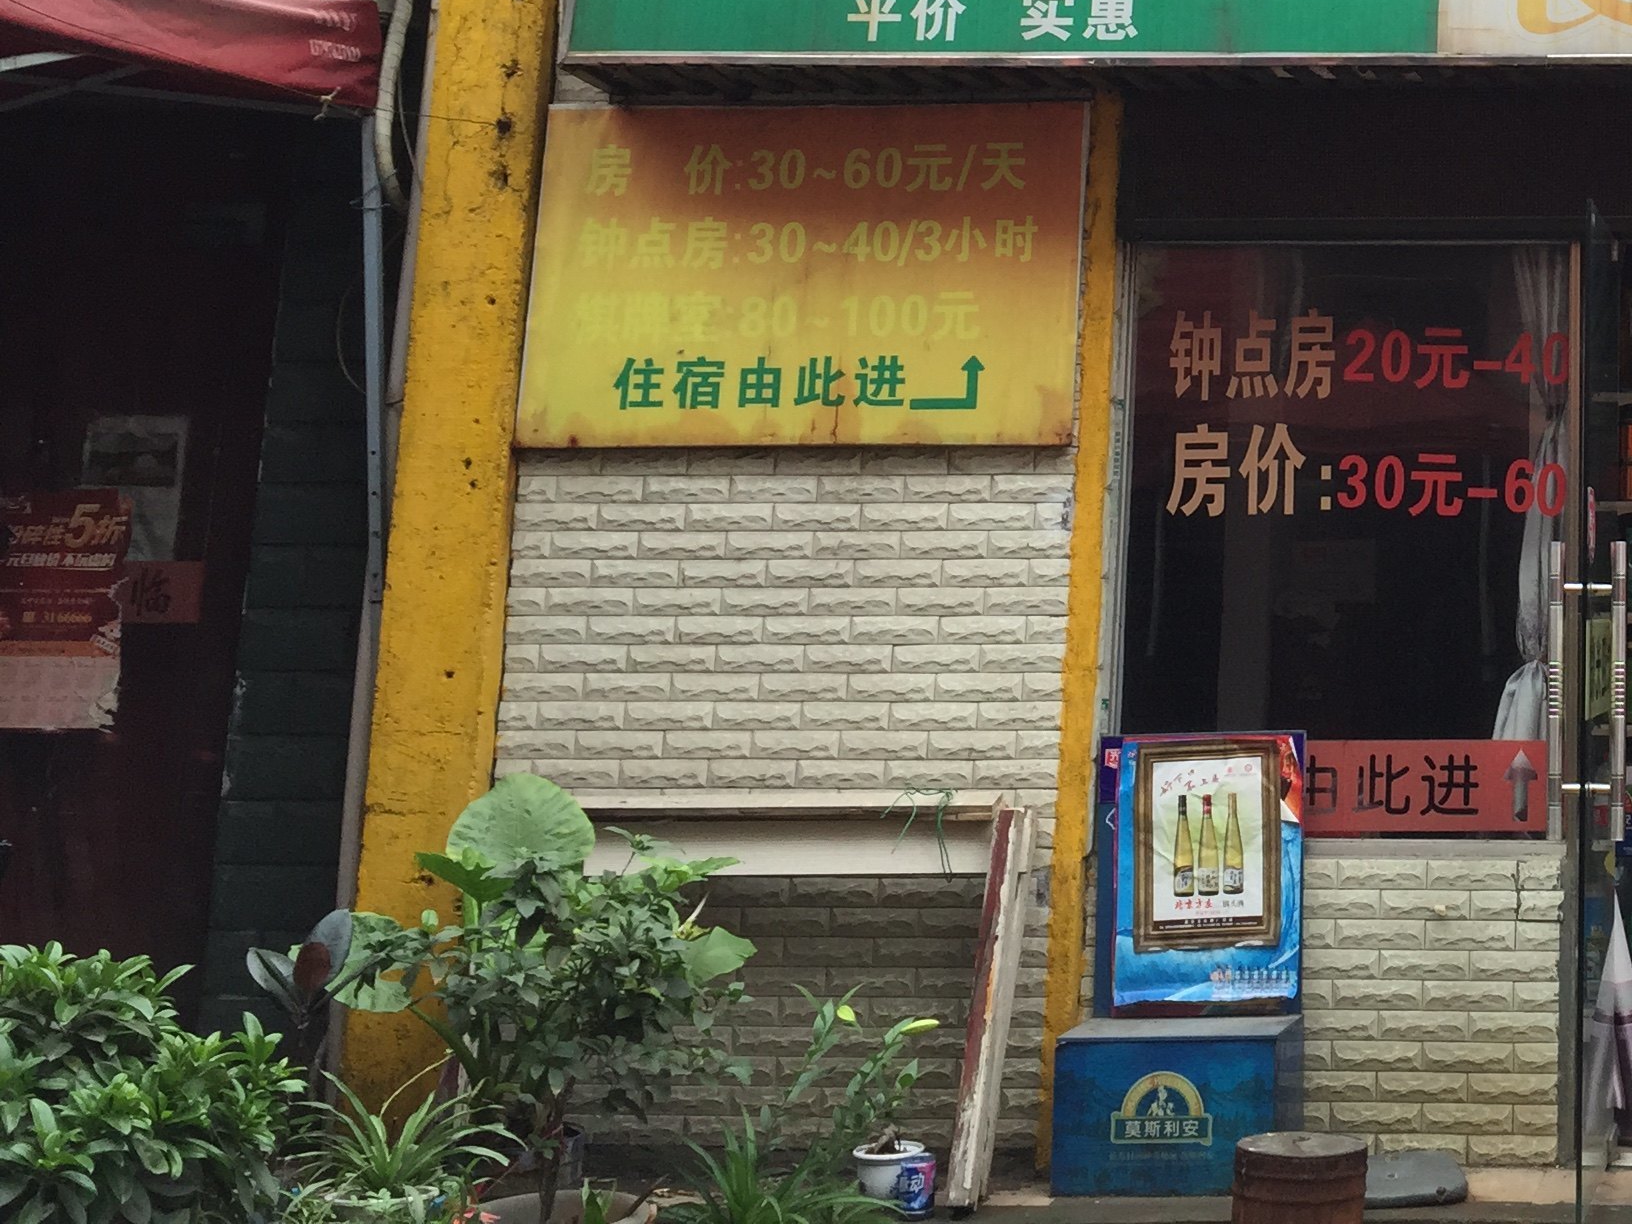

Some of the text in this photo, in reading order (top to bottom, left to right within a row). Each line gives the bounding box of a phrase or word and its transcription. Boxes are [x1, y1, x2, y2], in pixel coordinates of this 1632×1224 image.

[611, 356, 907, 410] 住宿由此进
[1124, 1119, 1200, 1139] 莫斯利安
